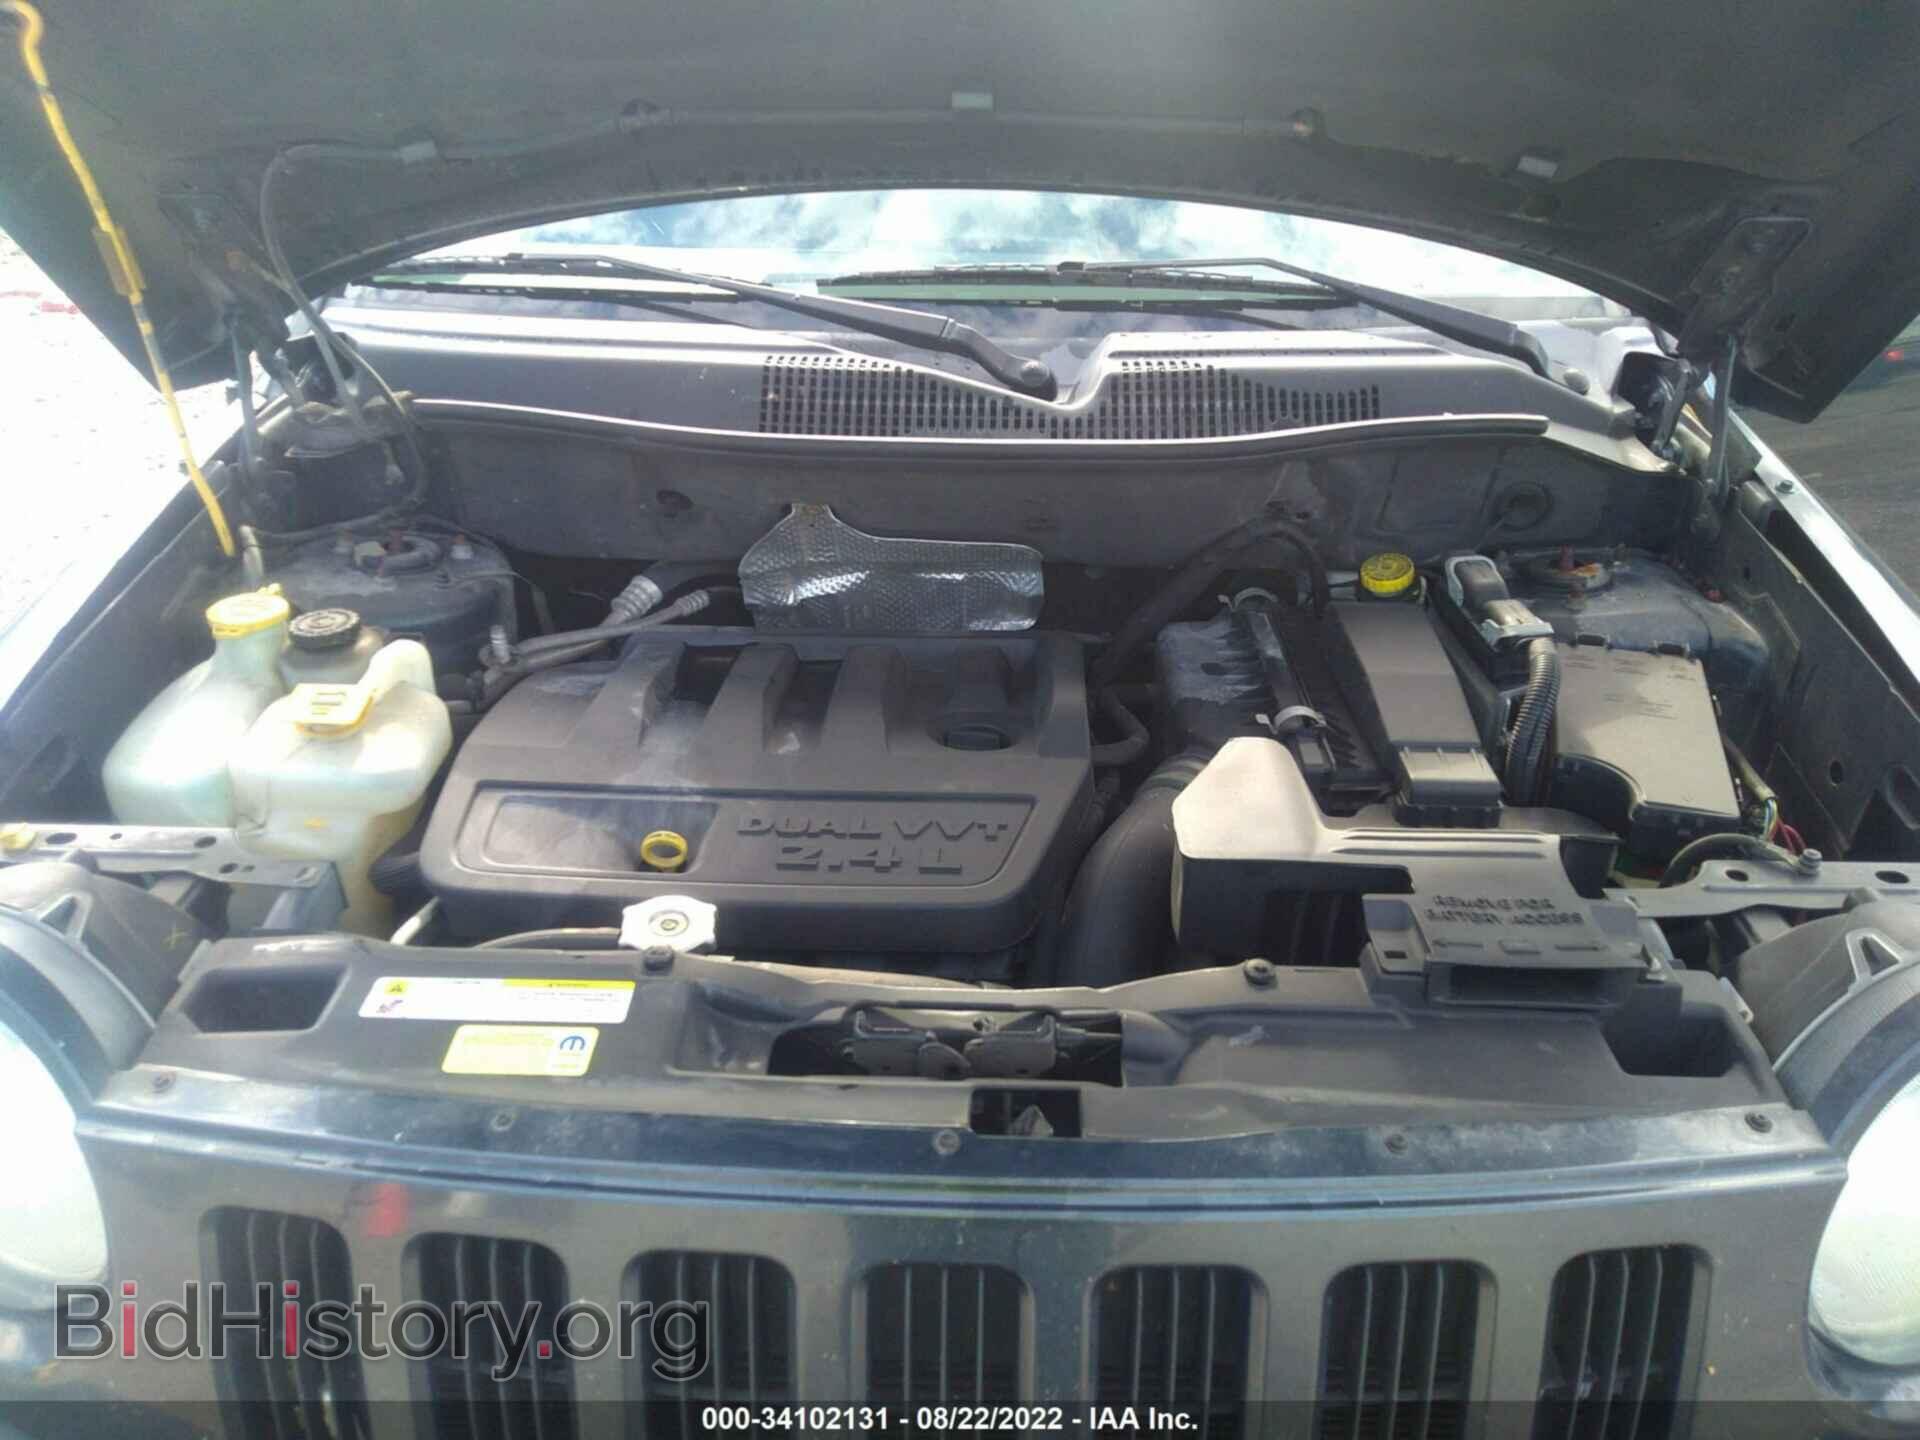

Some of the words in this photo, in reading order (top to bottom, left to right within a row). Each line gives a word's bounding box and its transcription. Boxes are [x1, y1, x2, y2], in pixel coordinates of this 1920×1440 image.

[737, 817, 882, 841] DUAL
[894, 820, 1009, 843] VVT
[1426, 908, 1502, 925] BATTERY
[1511, 911, 1585, 926] ACCESS
